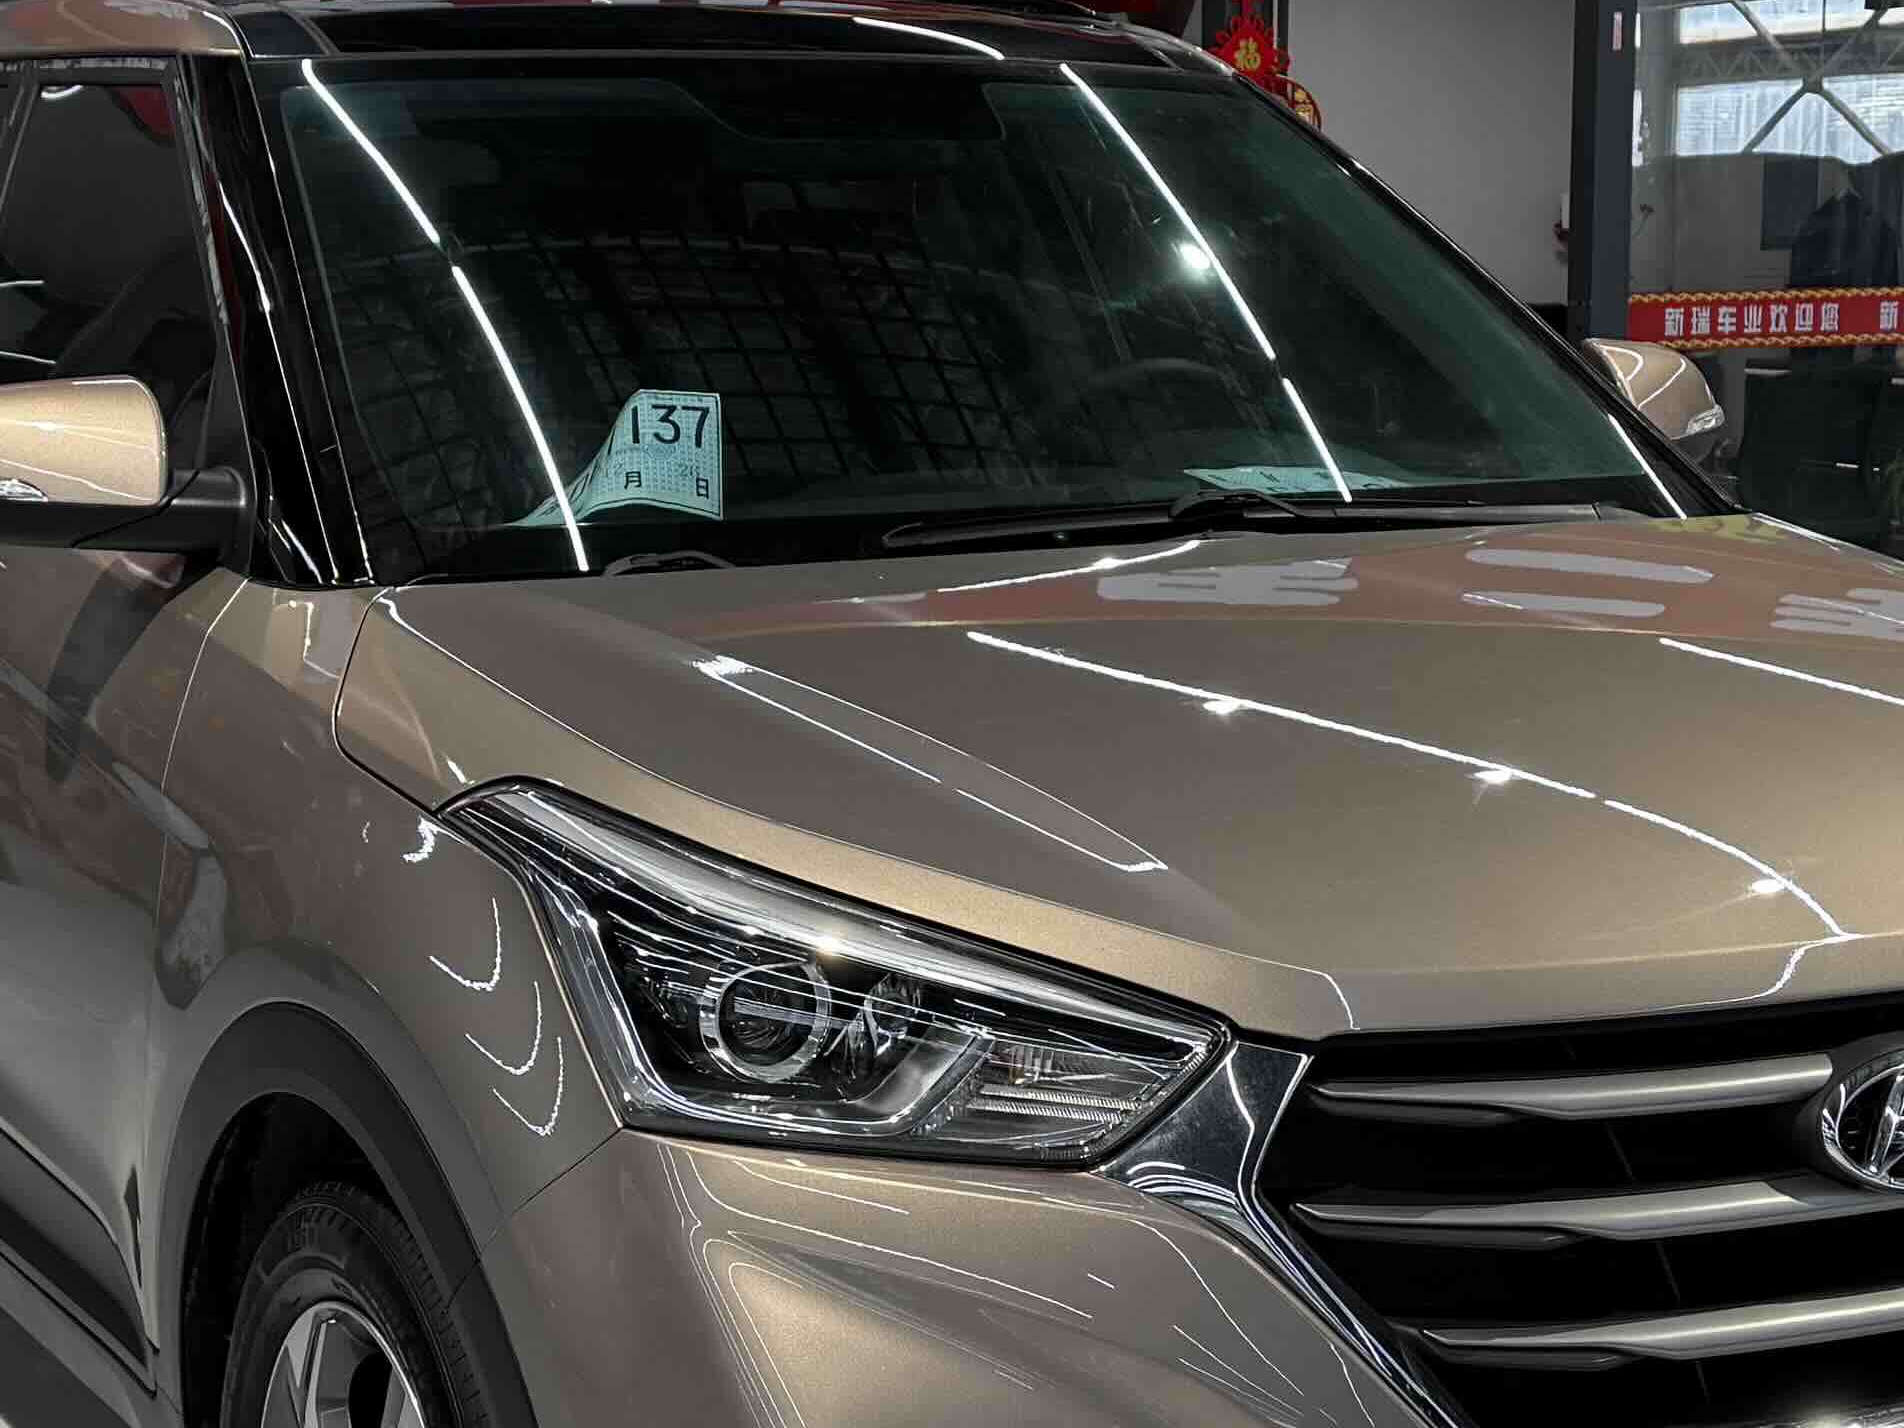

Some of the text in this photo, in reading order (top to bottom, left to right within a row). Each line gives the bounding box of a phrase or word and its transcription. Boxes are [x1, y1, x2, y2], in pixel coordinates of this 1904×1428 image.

[1664, 303, 1840, 337] 新瑞车业欢迎您
